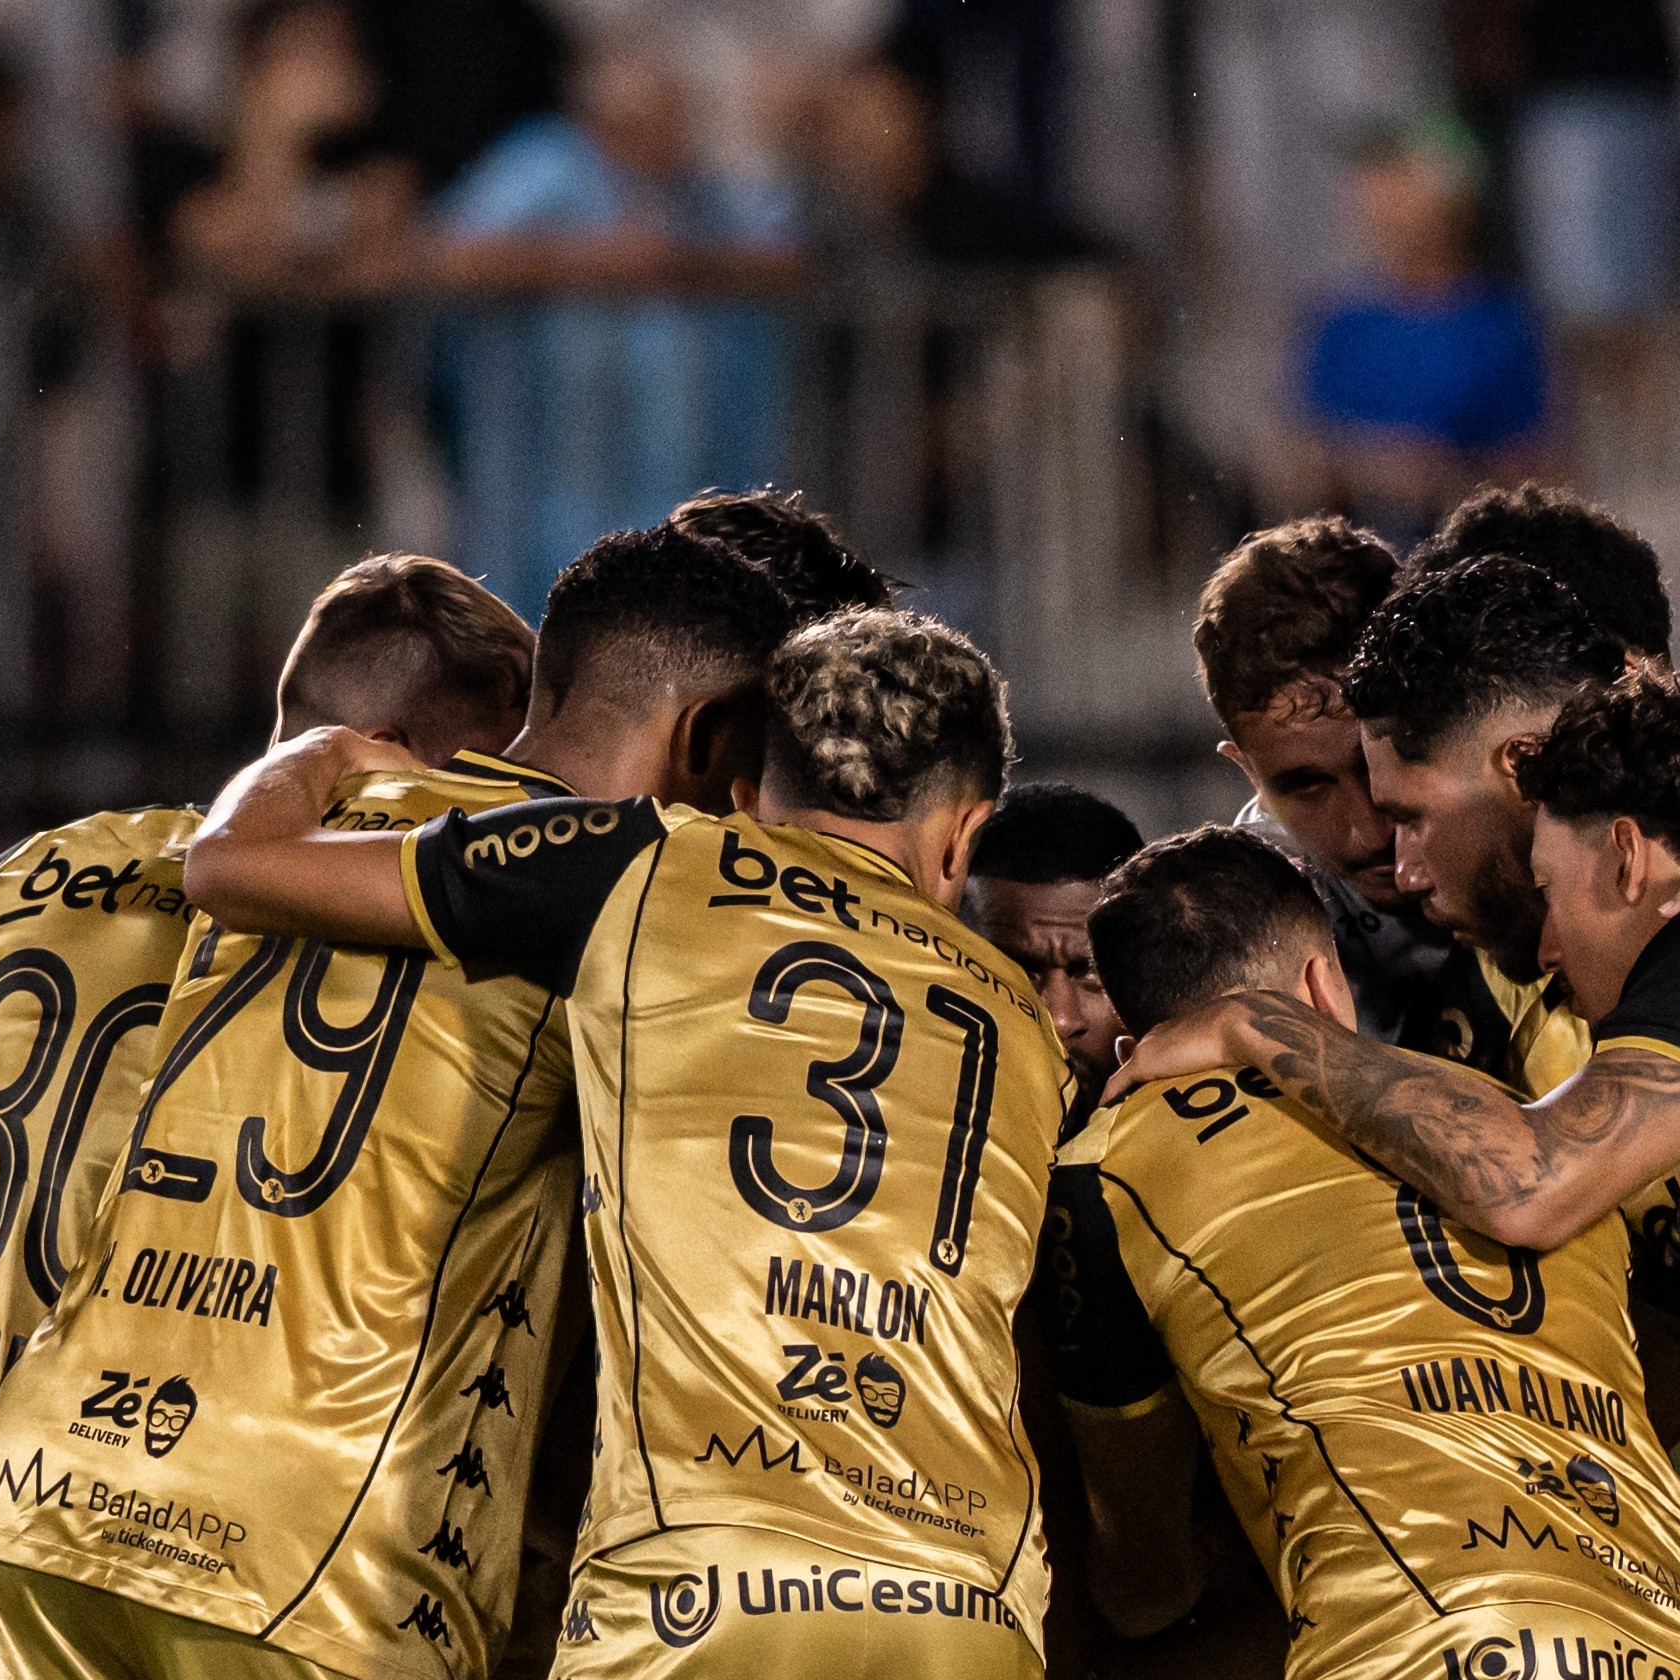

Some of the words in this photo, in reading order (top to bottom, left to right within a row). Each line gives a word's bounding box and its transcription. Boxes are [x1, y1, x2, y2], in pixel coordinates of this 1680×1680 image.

[728, 940, 999, 1278] 31
[121, 1247, 279, 1328] OLIVEIRA
[764, 1255, 931, 1346] MARLON
[80, 1369, 151, 1429] Zé
[775, 1343, 854, 1403] Zé
[67, 1421, 132, 1450] DELIVERY
[776, 1403, 850, 1424] DELIVERY
[1518, 1365, 1628, 1448] ALANO
[87, 1481, 247, 1551] BaladAPP
[822, 1454, 988, 1517] BaladAPP
[842, 1490, 860, 1507] by
[100, 1527, 117, 1545] by
